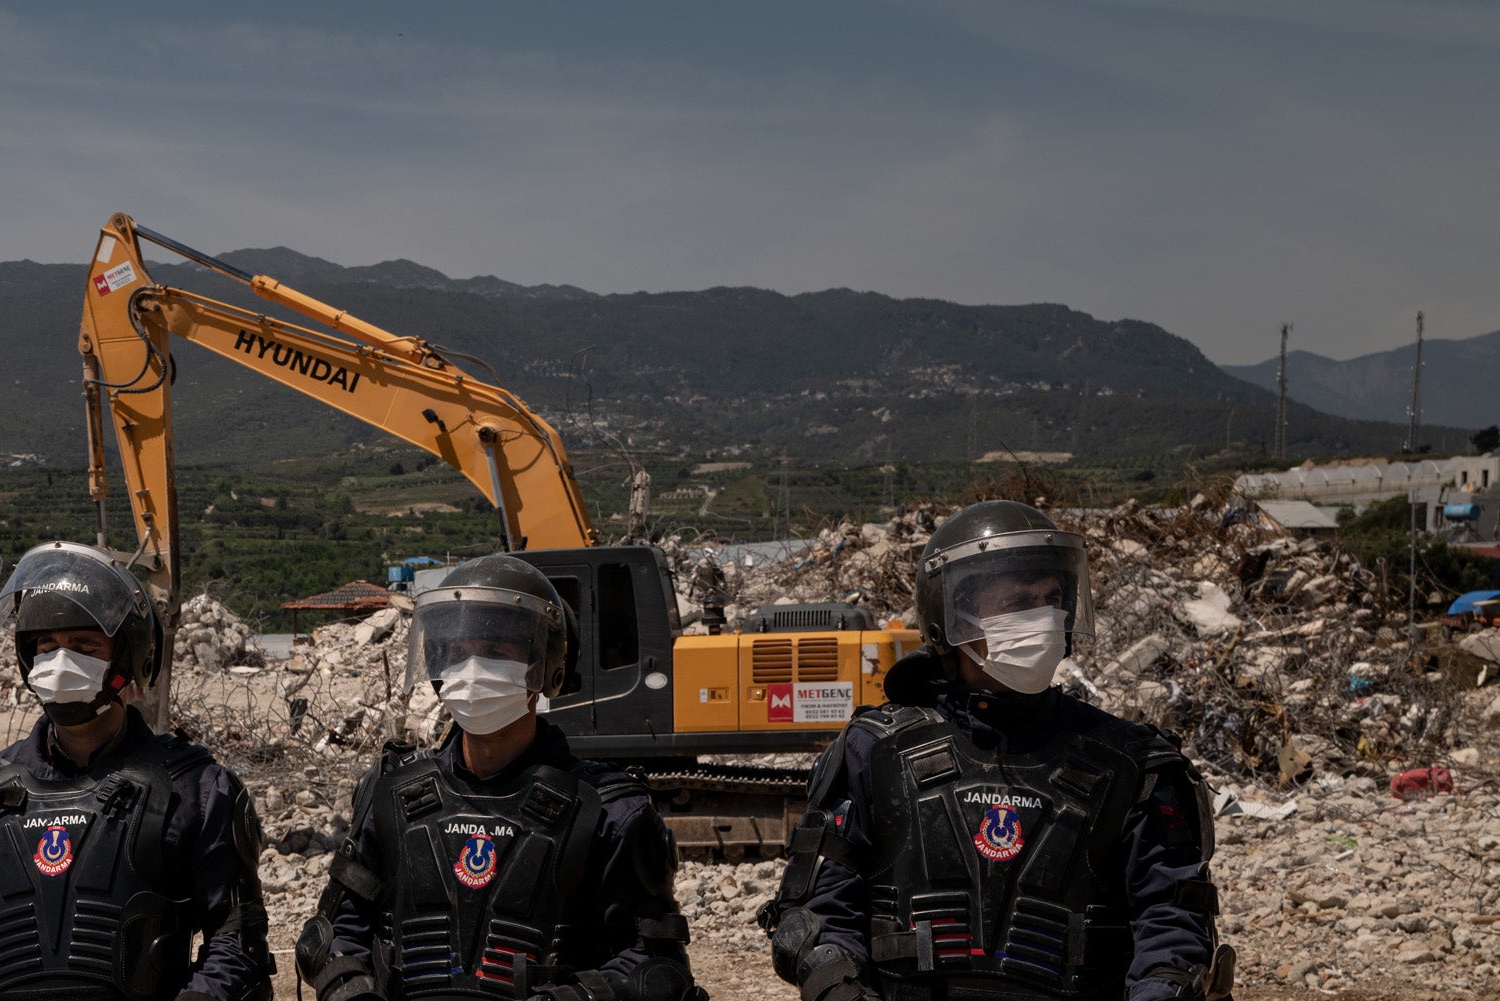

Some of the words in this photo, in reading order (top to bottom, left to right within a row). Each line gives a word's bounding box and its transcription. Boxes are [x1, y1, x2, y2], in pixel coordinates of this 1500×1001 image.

[234, 329, 360, 393] HYUNDAI
[963, 792, 1043, 809] JANDARMA
[444, 823, 514, 837] JANDAMA
[974, 840, 1024, 858] JANDARMA
[34, 859, 73, 873] JANDARMA
[454, 867, 497, 886] JANDARMA
